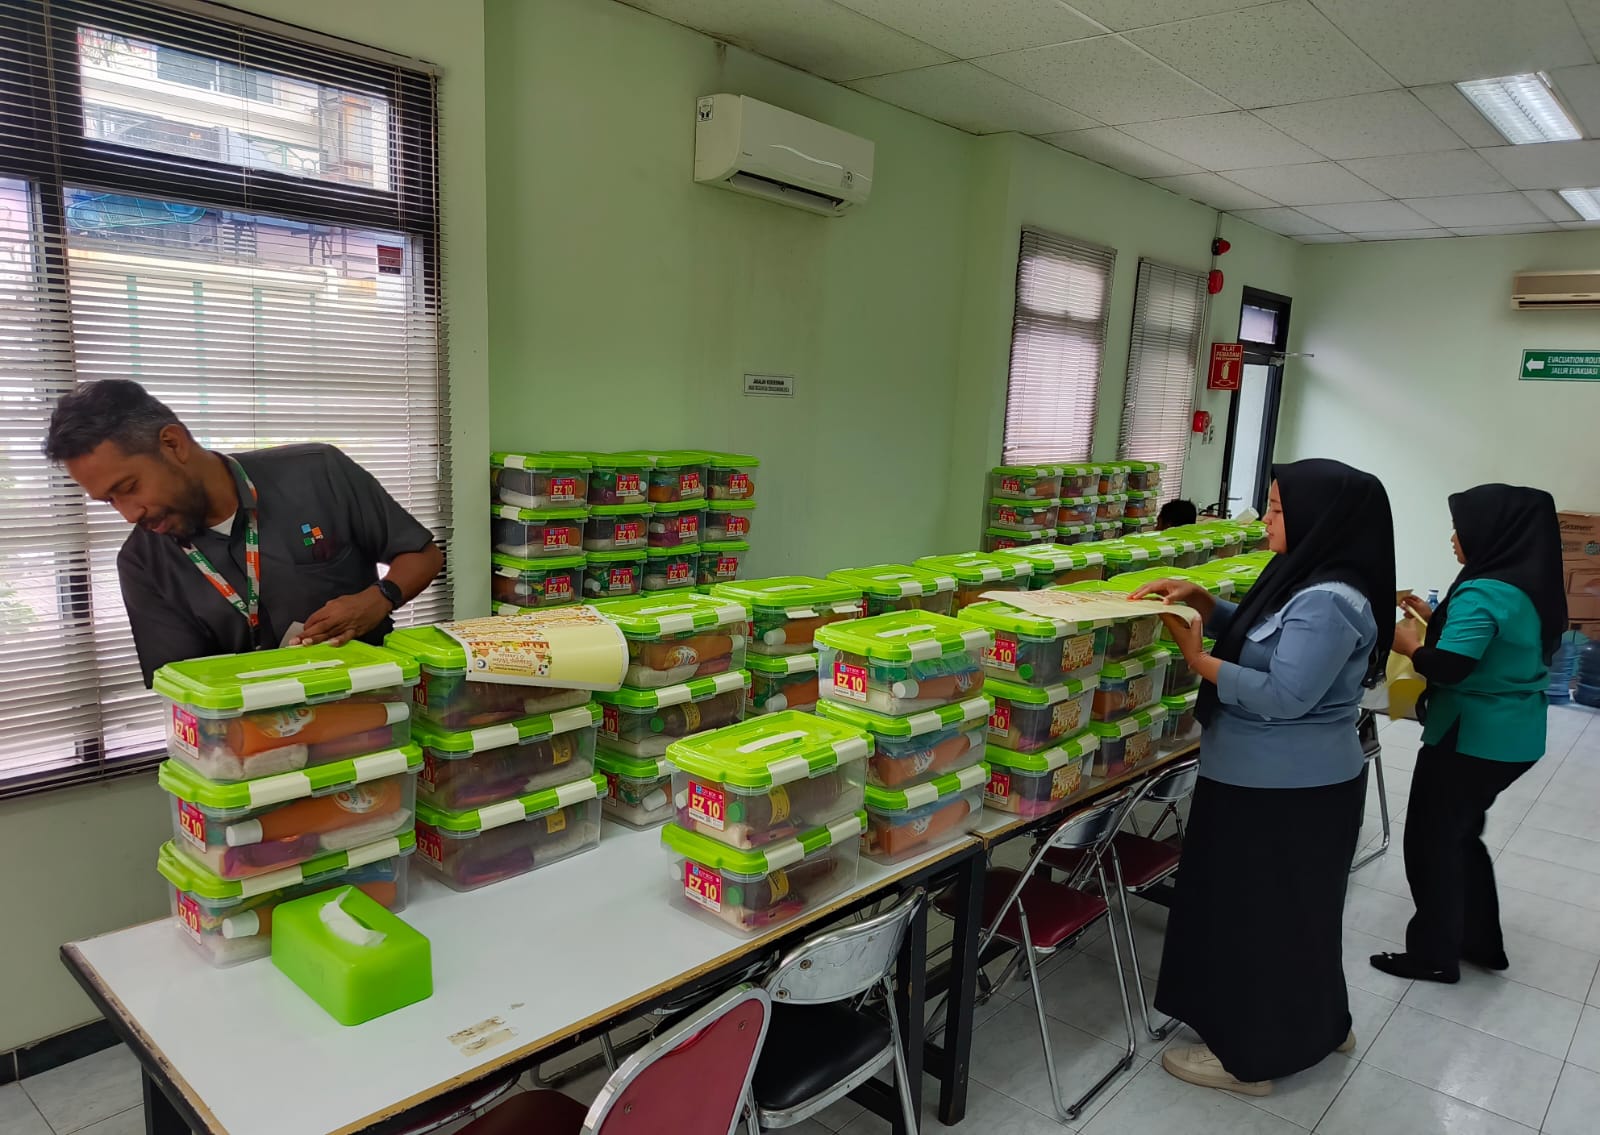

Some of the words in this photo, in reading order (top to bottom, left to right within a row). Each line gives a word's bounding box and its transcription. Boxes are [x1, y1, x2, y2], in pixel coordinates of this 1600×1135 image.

[554, 486, 563, 494] EZ
[564, 485, 572, 494] 10
[619, 482, 628, 490] EZ
[629, 481, 636, 489] 10
[683, 481, 691, 490] EZ
[692, 480, 697, 488] 10
[732, 481, 739, 489] EZ
[740, 480, 746, 488] 10
[681, 523, 689, 531] EZ
[690, 522, 695, 530] 10
[728, 524, 736, 532] EZ
[737, 523, 743, 531] 10
[547, 536, 556, 544] EZ
[557, 535, 566, 544] 10
[618, 531, 627, 539] EZ
[628, 530, 635, 538] 10
[720, 563, 727, 571] EZ
[612, 576, 621, 584] EZ
[622, 575, 629, 583] 10
[669, 570, 677, 578] EZ
[679, 570, 685, 578] 10
[548, 584, 557, 593] EZ
[558, 583, 567, 592] 10
[1000, 648, 1011, 660] 10
[837, 672, 848, 688] EZ
[851, 676, 863, 691] 10
[415, 688, 424, 704] 10
[605, 717, 614, 730] 10
[993, 714, 1005, 727] 10
[176, 723, 184, 741] EZ
[185, 727, 195, 745] 10
[992, 782, 1004, 795] 10
[692, 794, 704, 812] EZ
[707, 800, 720, 818] 10
[181, 813, 190, 830] EZ
[192, 817, 202, 835] 10
[419, 840, 429, 854] EZ
[430, 845, 439, 860] 10
[689, 874, 702, 894] EZ
[704, 882, 717, 900] 10
[178, 903, 188, 922] EZ
[188, 908, 198, 927] 10
